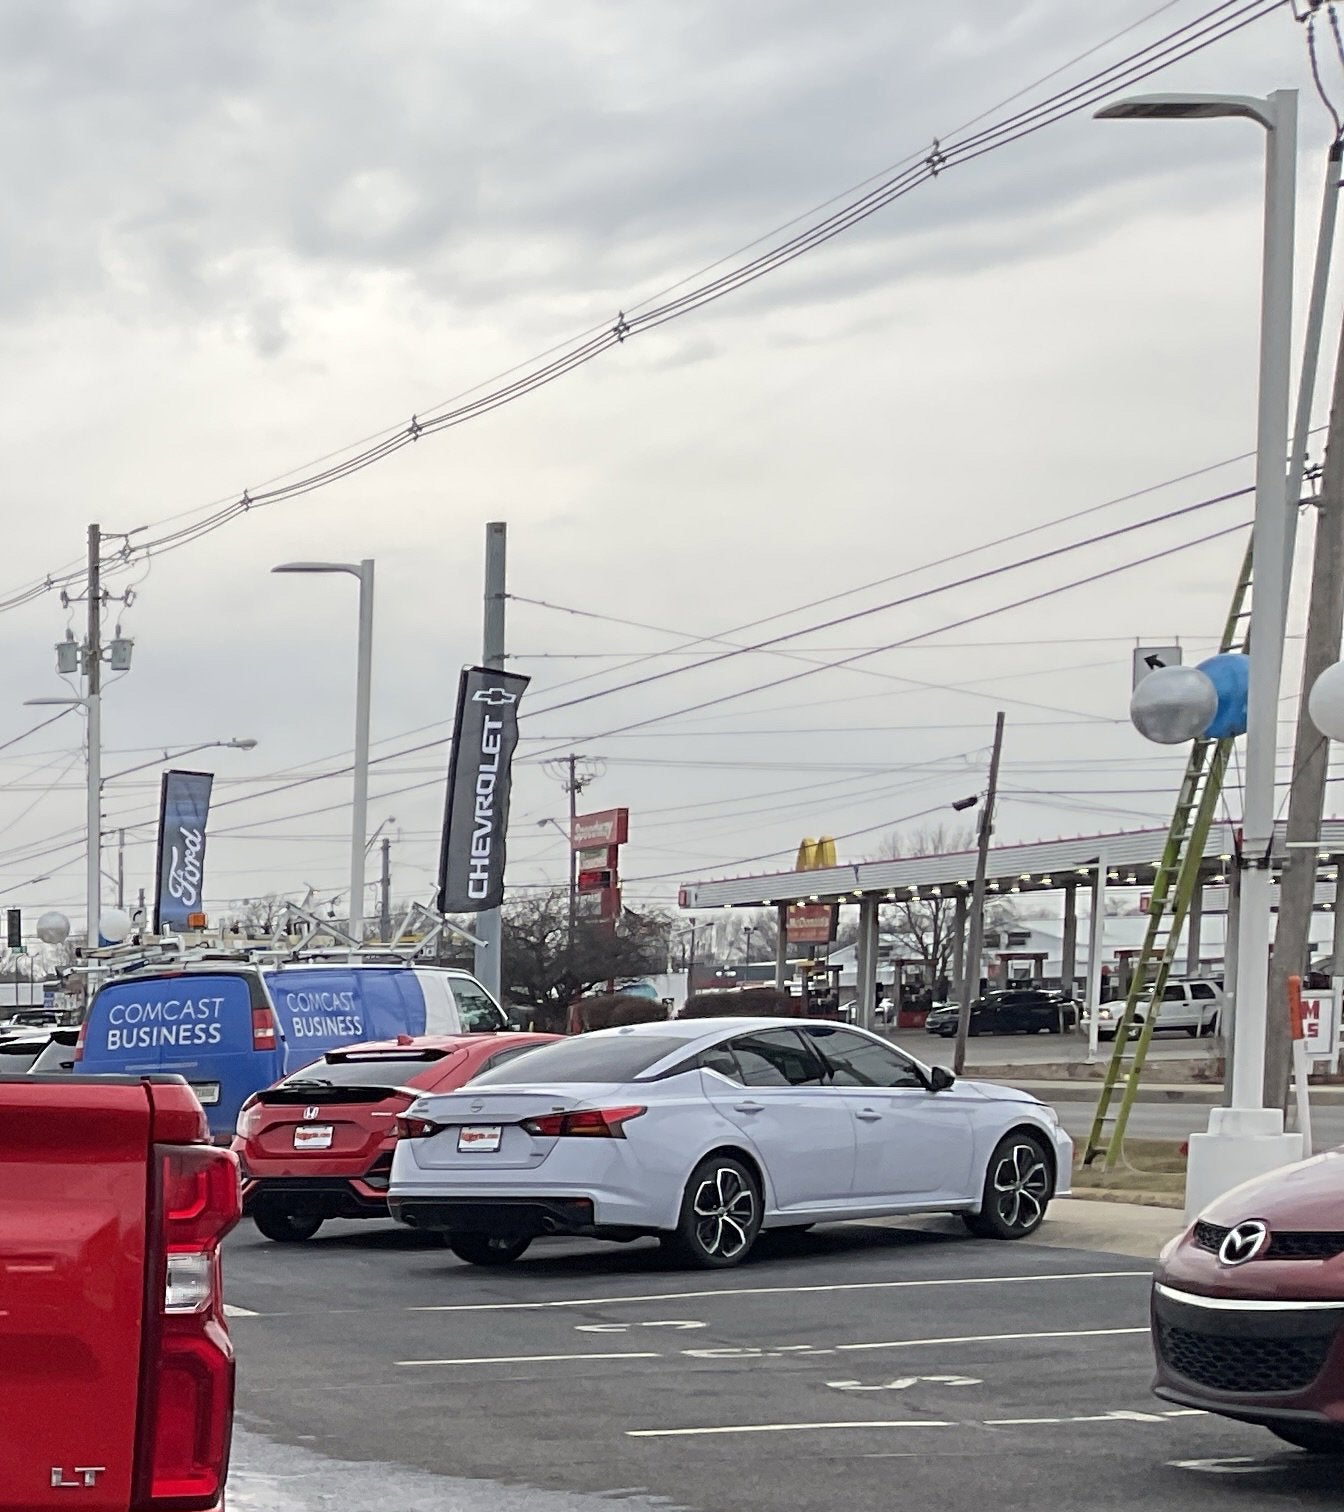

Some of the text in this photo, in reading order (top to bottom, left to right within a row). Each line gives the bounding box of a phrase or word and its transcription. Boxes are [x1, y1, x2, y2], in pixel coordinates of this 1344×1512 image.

[468, 714, 504, 898] CHEVROLET
[168, 826, 202, 906] Ford
[109, 998, 224, 1025] COMCAST
[285, 992, 354, 1012] COMCAST
[107, 1023, 222, 1050] BUSINESS
[292, 1016, 363, 1038] BUSINESS
[50, 1465, 107, 1488] LT
